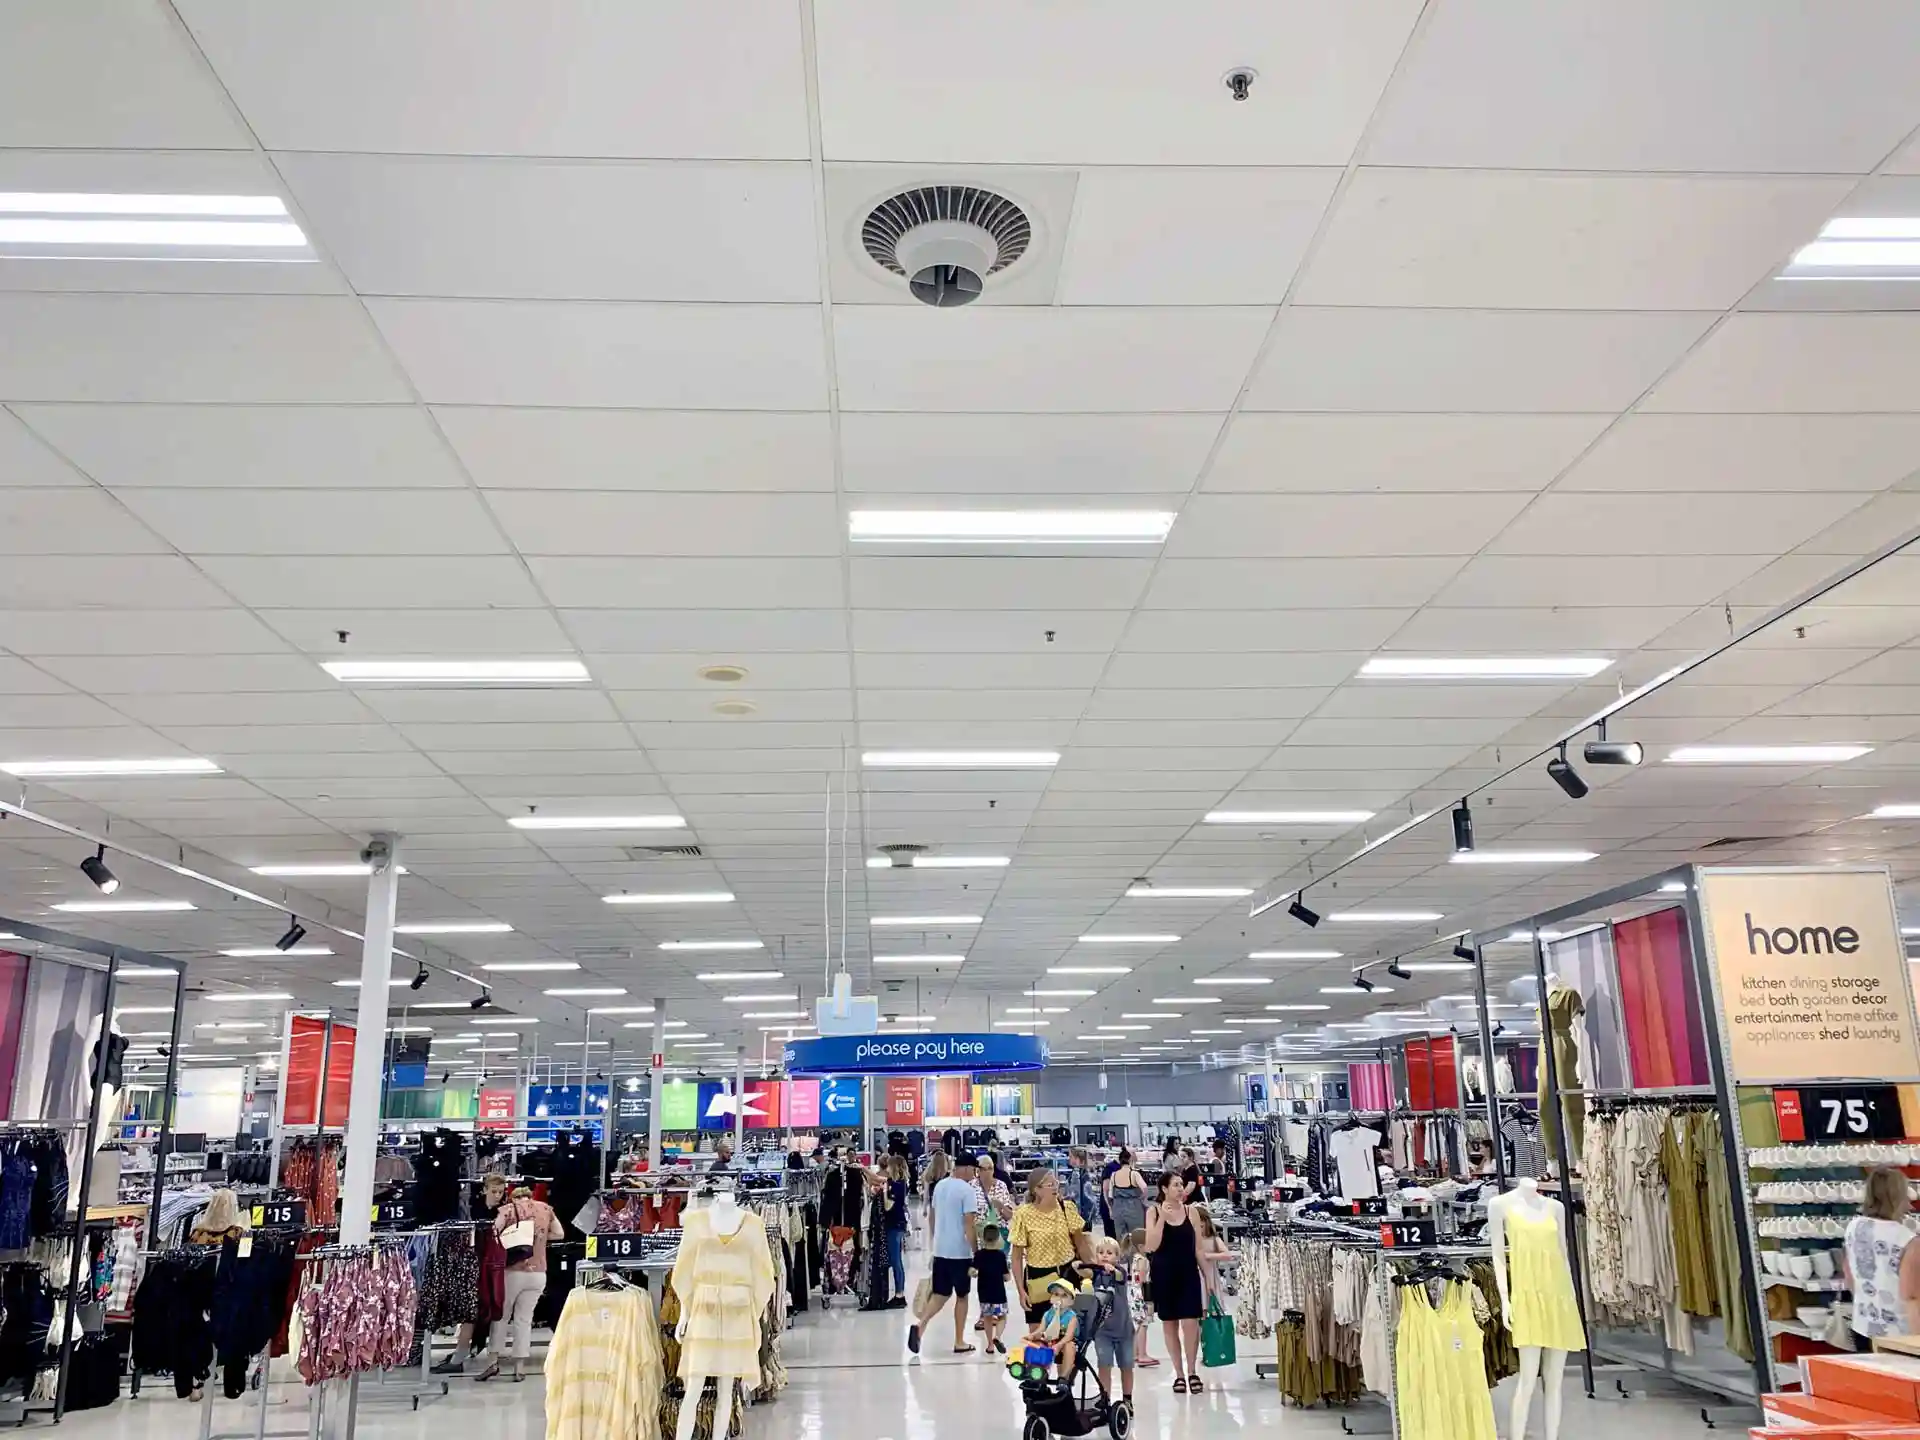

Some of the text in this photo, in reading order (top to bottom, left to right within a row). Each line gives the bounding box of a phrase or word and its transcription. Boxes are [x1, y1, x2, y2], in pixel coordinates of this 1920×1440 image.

[1744, 912, 1861, 955] home
[1742, 976, 1880, 992] kitchen dining storage
[1739, 992, 1888, 1008] bed bath garden decor
[1735, 1008, 1898, 1024] entertainment home office
[1747, 1027, 1901, 1045] appliances shed laundry
[856, 1038, 985, 1061] please pay here
[267, 1207, 292, 1222] $15
[384, 1206, 404, 1218] $15
[1395, 1226, 1421, 1243] $12
[606, 1239, 631, 1255] $18
